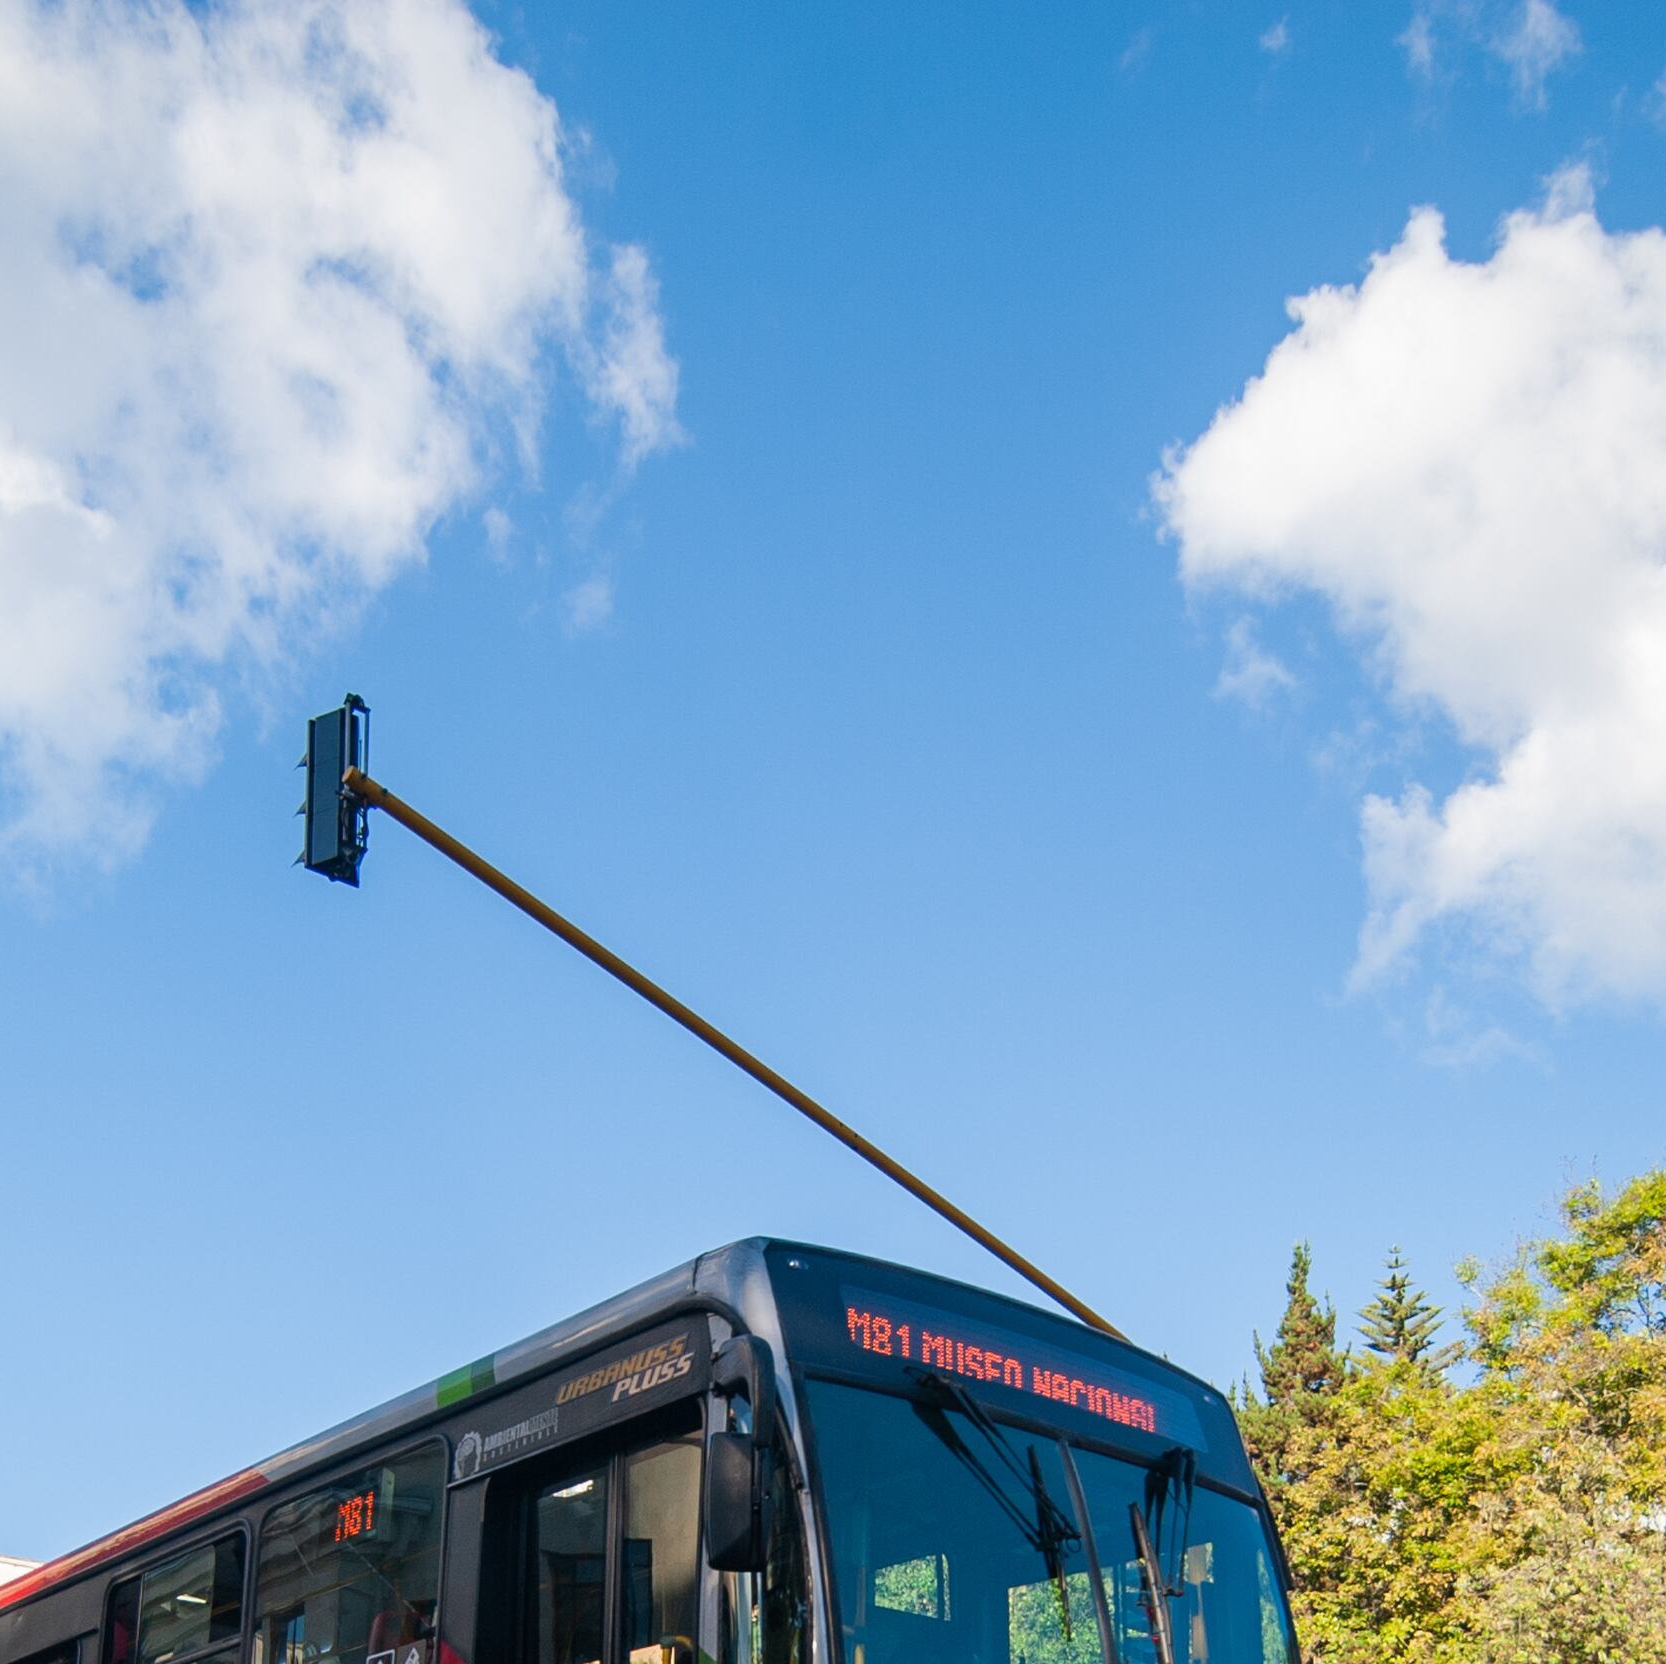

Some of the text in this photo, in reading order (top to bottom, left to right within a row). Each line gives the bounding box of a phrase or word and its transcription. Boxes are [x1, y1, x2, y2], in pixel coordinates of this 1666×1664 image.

[847, 1306, 911, 1358] M81
[556, 1332, 690, 1405] URBANUSS
[611, 1351, 695, 1404] PLUSS
